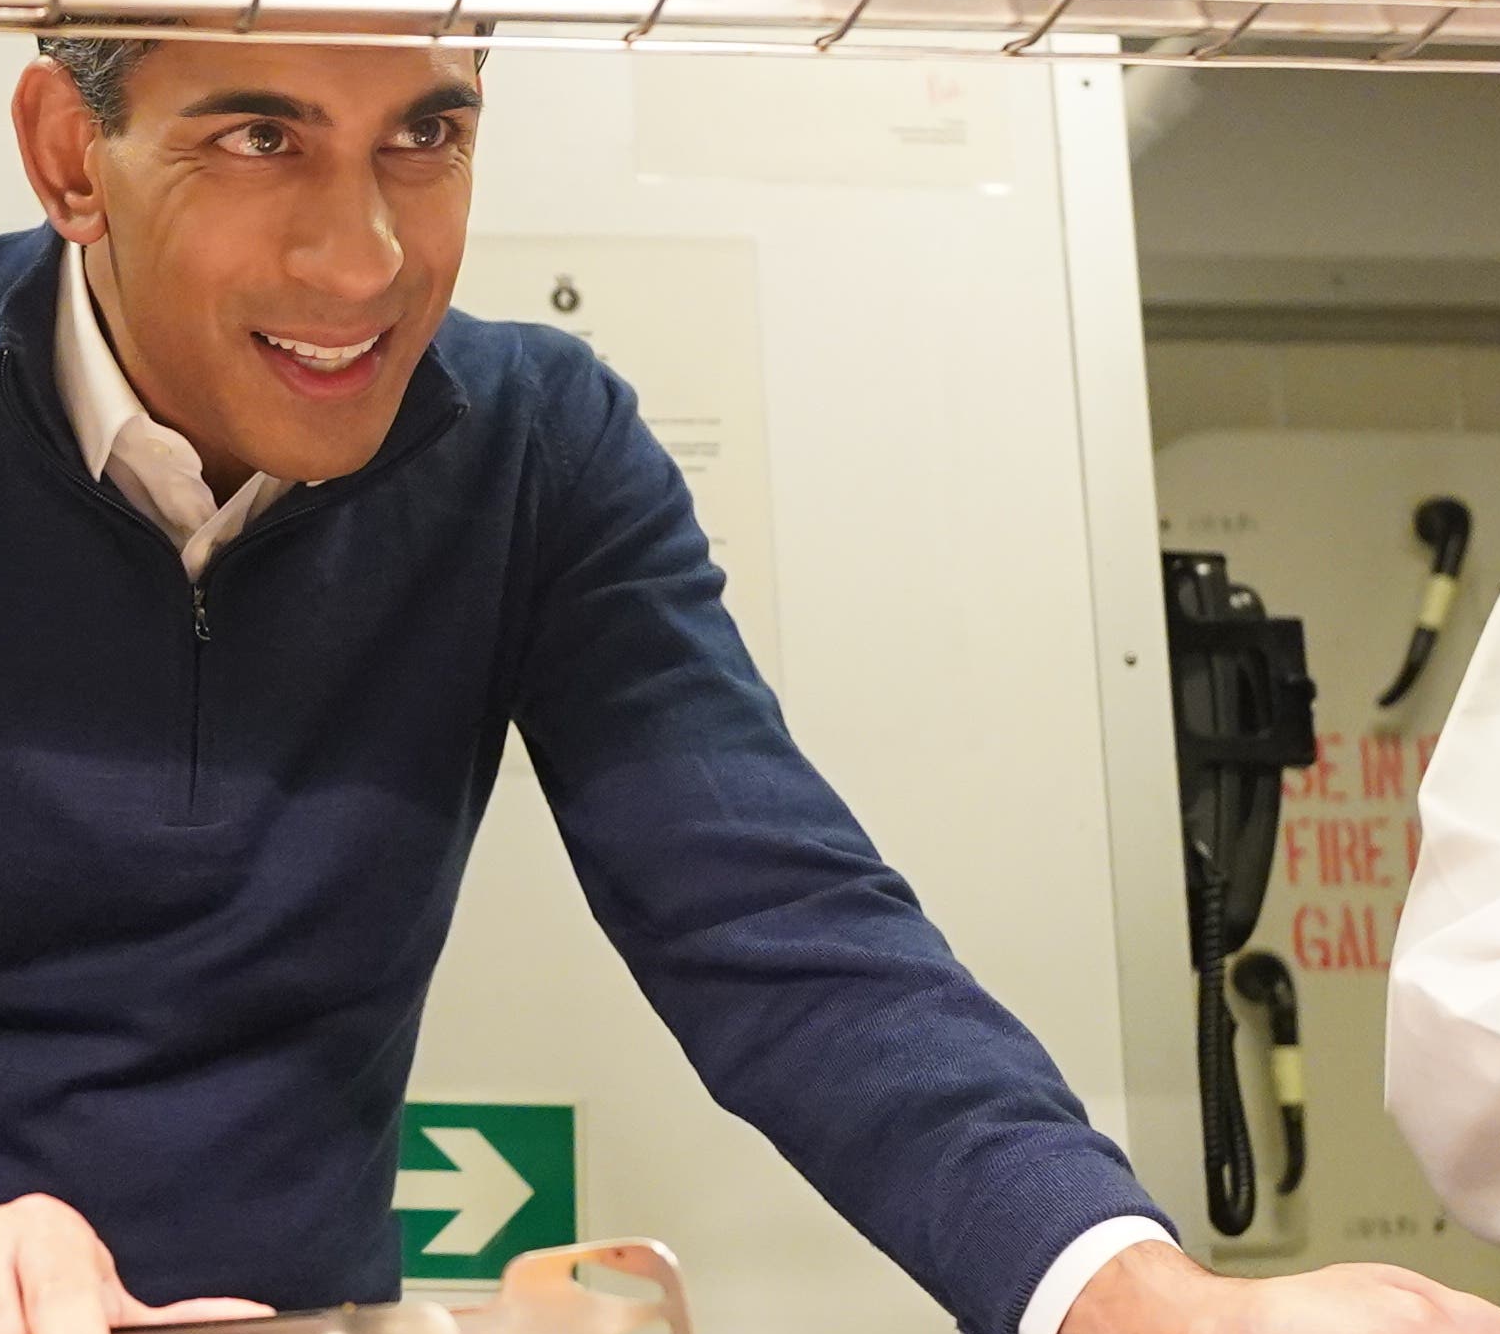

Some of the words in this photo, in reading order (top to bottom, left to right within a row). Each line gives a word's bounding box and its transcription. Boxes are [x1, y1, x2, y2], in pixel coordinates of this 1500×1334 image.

[1359, 734, 1404, 798] IN
[1285, 817, 1393, 887] FIRE
[1291, 900, 1403, 971] GAL
